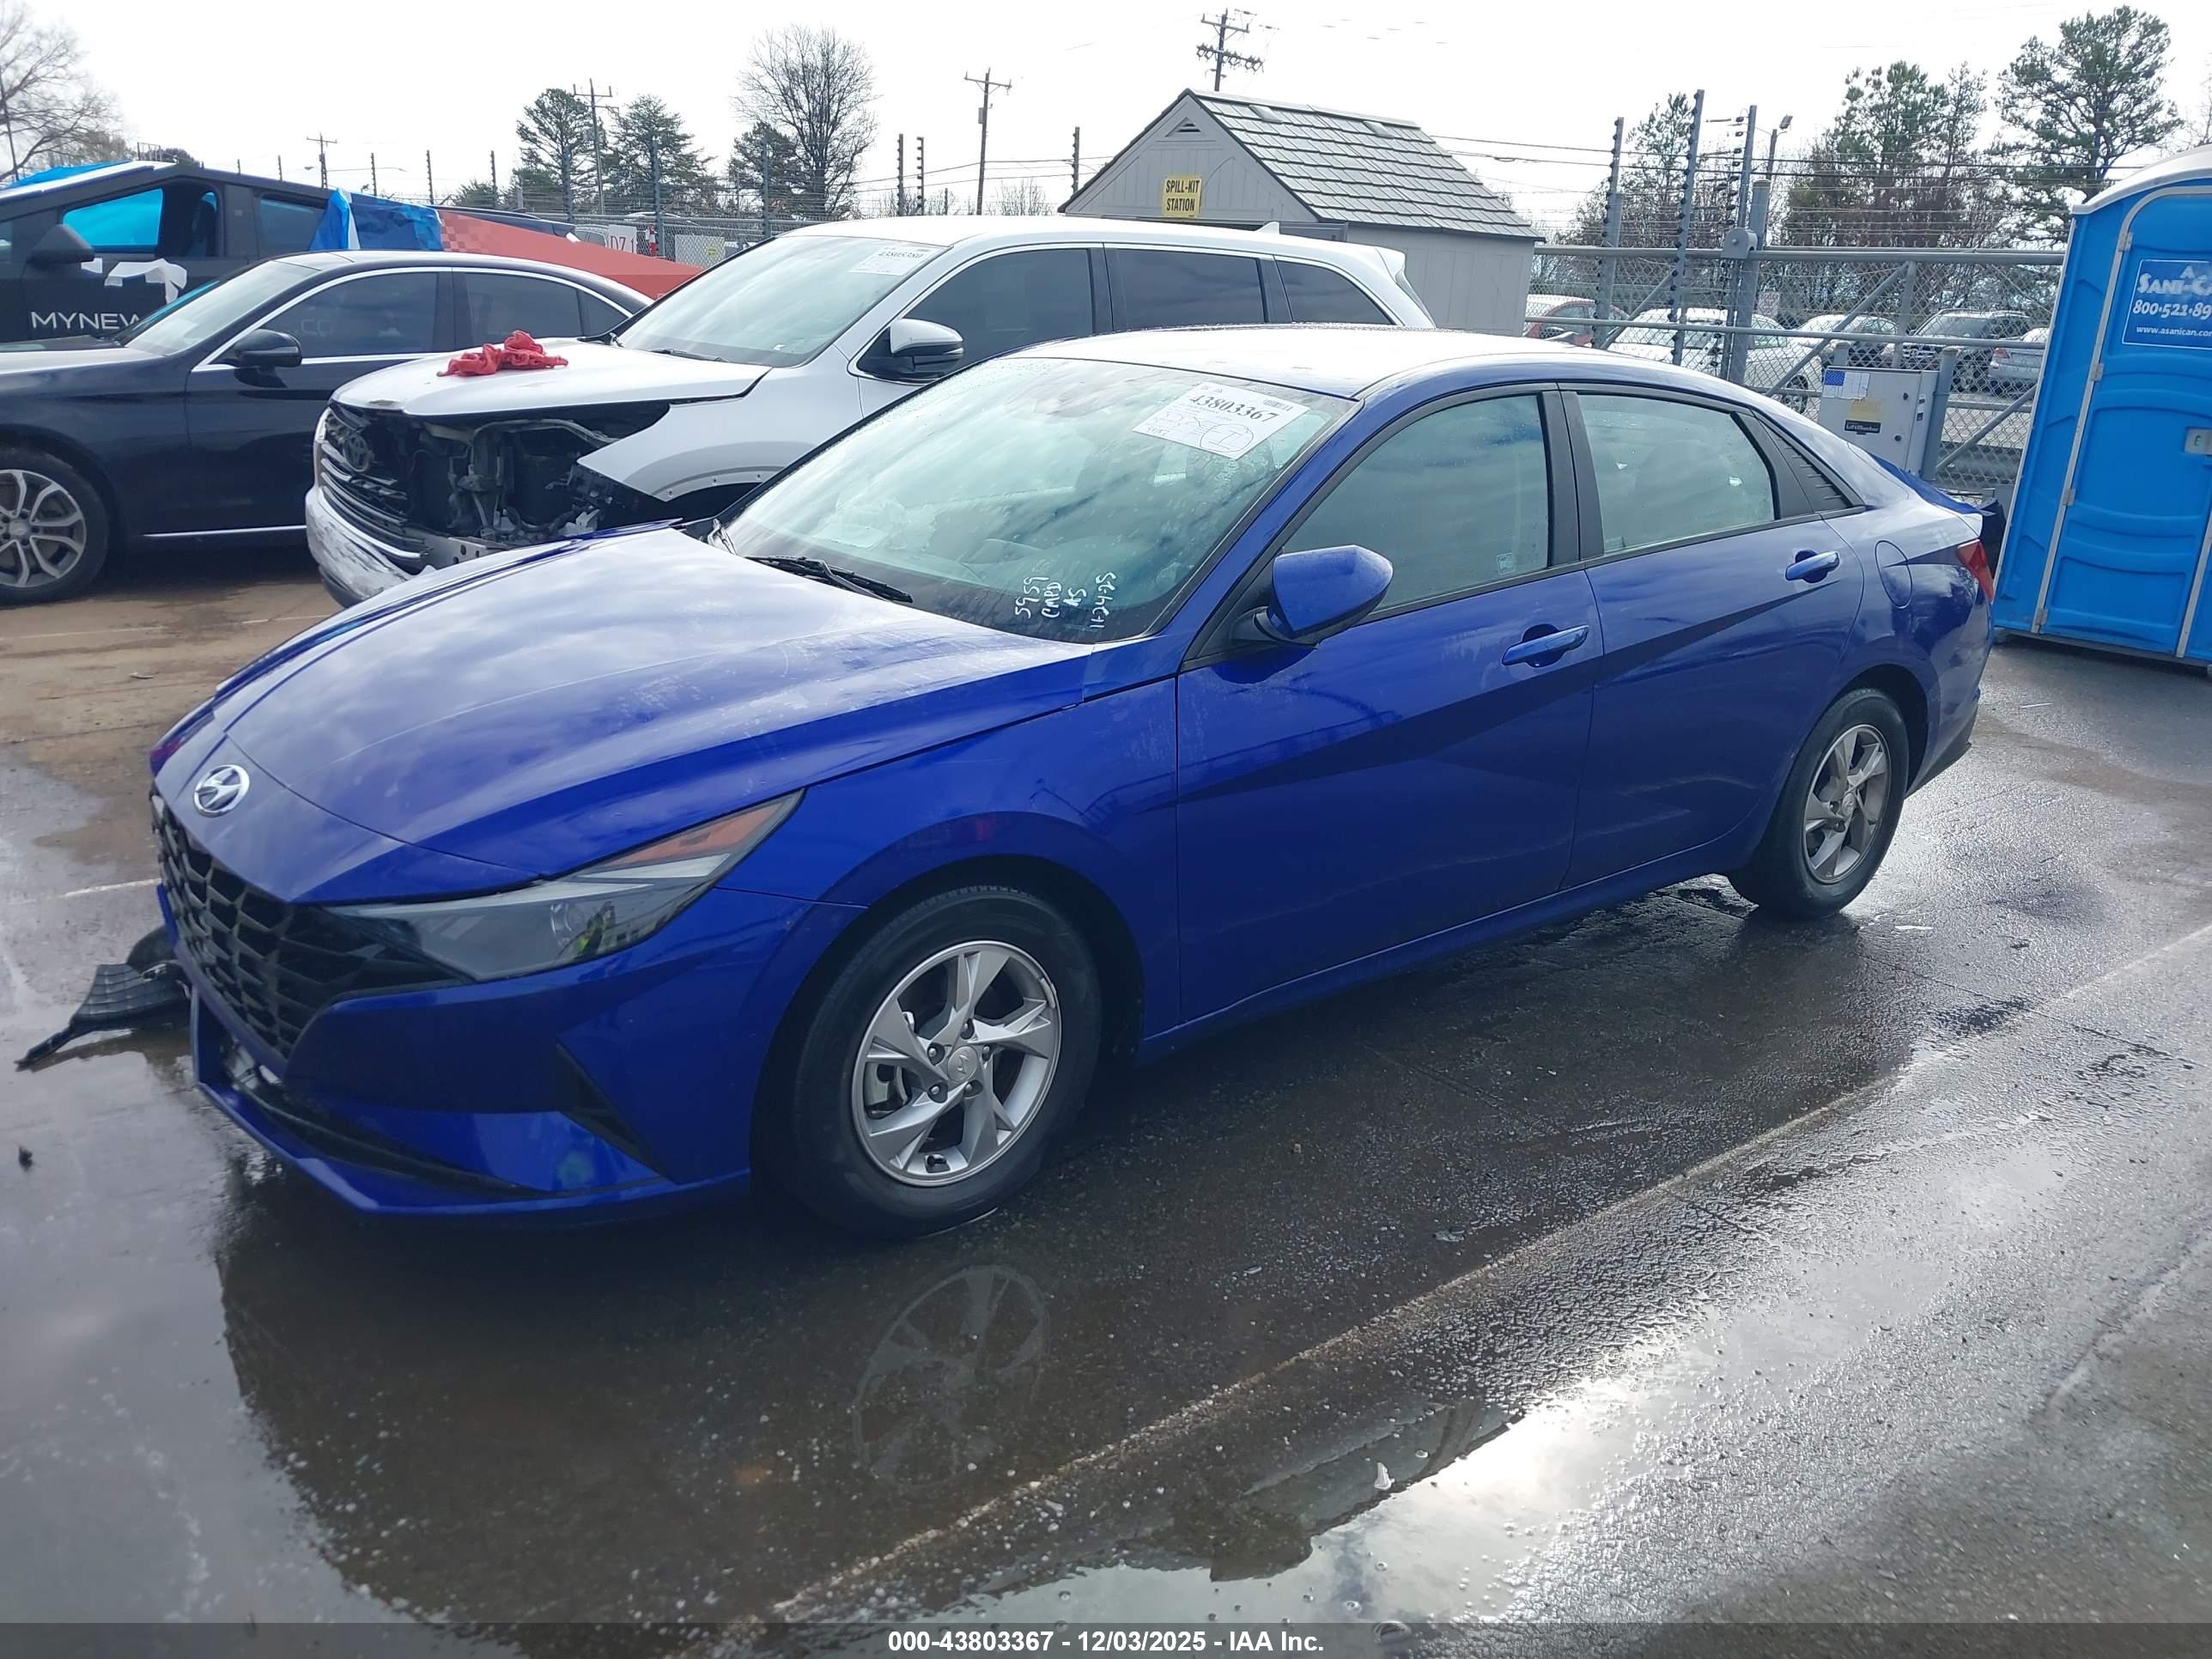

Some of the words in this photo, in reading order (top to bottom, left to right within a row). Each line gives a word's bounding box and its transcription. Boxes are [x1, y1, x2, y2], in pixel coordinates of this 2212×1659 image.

[1166, 179, 1200, 193] SPILL-KIT
[1166, 198, 1195, 211] STATION
[2179, 265, 2195, 278] A
[1189, 394, 1279, 422] 43803367
